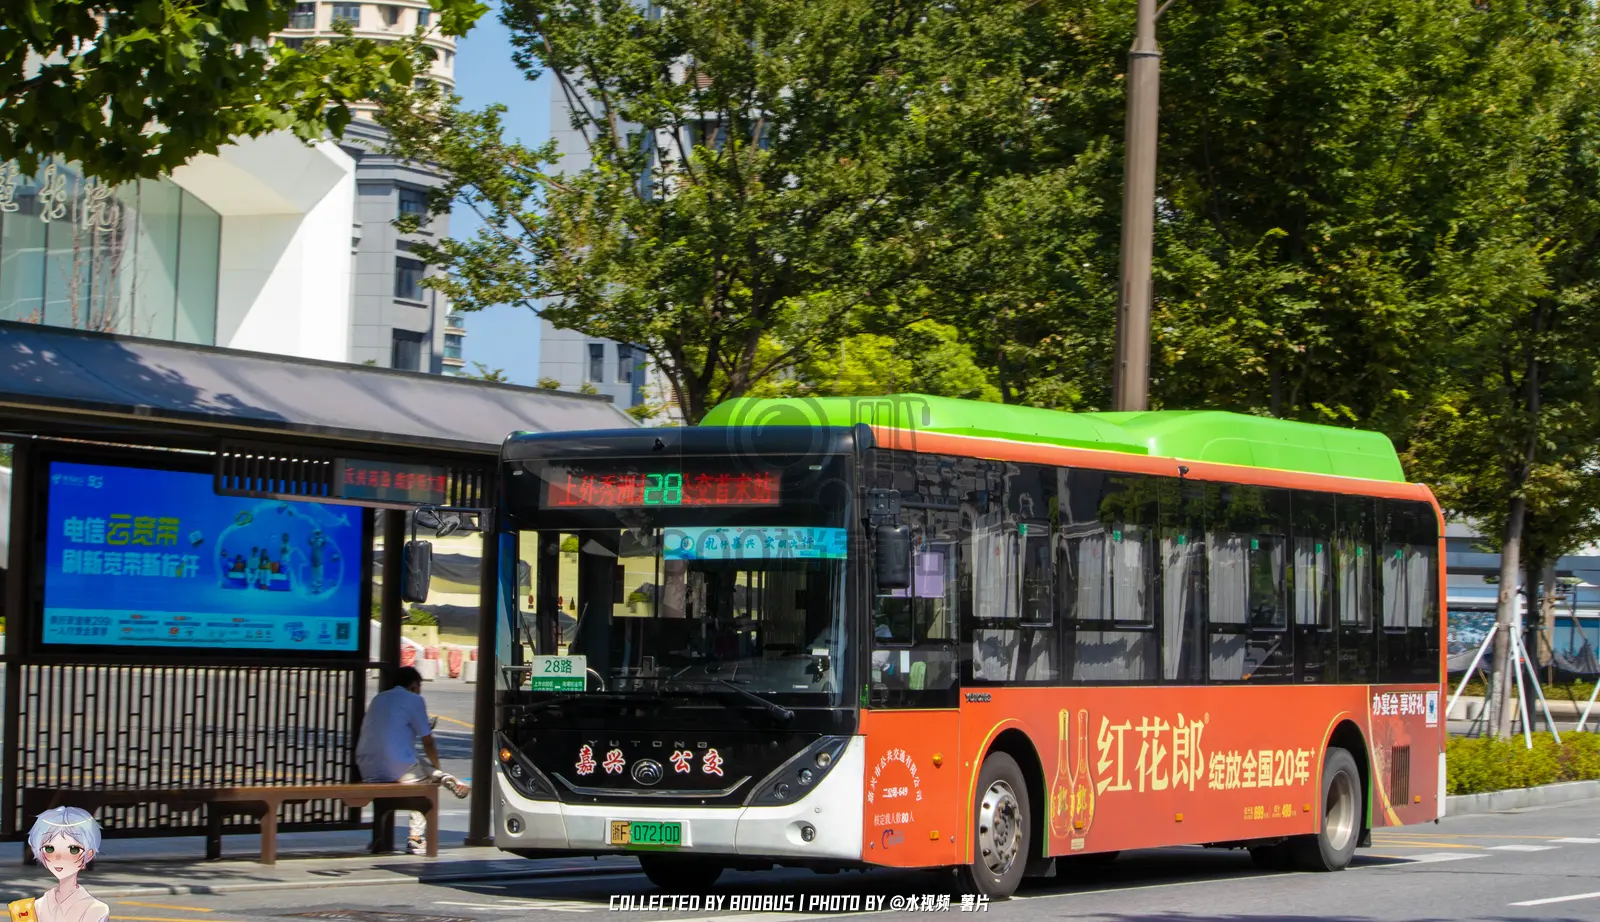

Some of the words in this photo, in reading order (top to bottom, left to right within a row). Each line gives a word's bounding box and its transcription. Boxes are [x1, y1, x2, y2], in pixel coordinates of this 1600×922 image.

[643, 473, 682, 504] 28
[63, 513, 181, 546] 电信云宽带
[62, 548, 200, 578] 刷新宽带新标杆
[544, 659, 573, 674] 28路
[575, 744, 626, 776] 嘉兴
[669, 748, 724, 777] 公交
[1096, 712, 1206, 797] 红花郎
